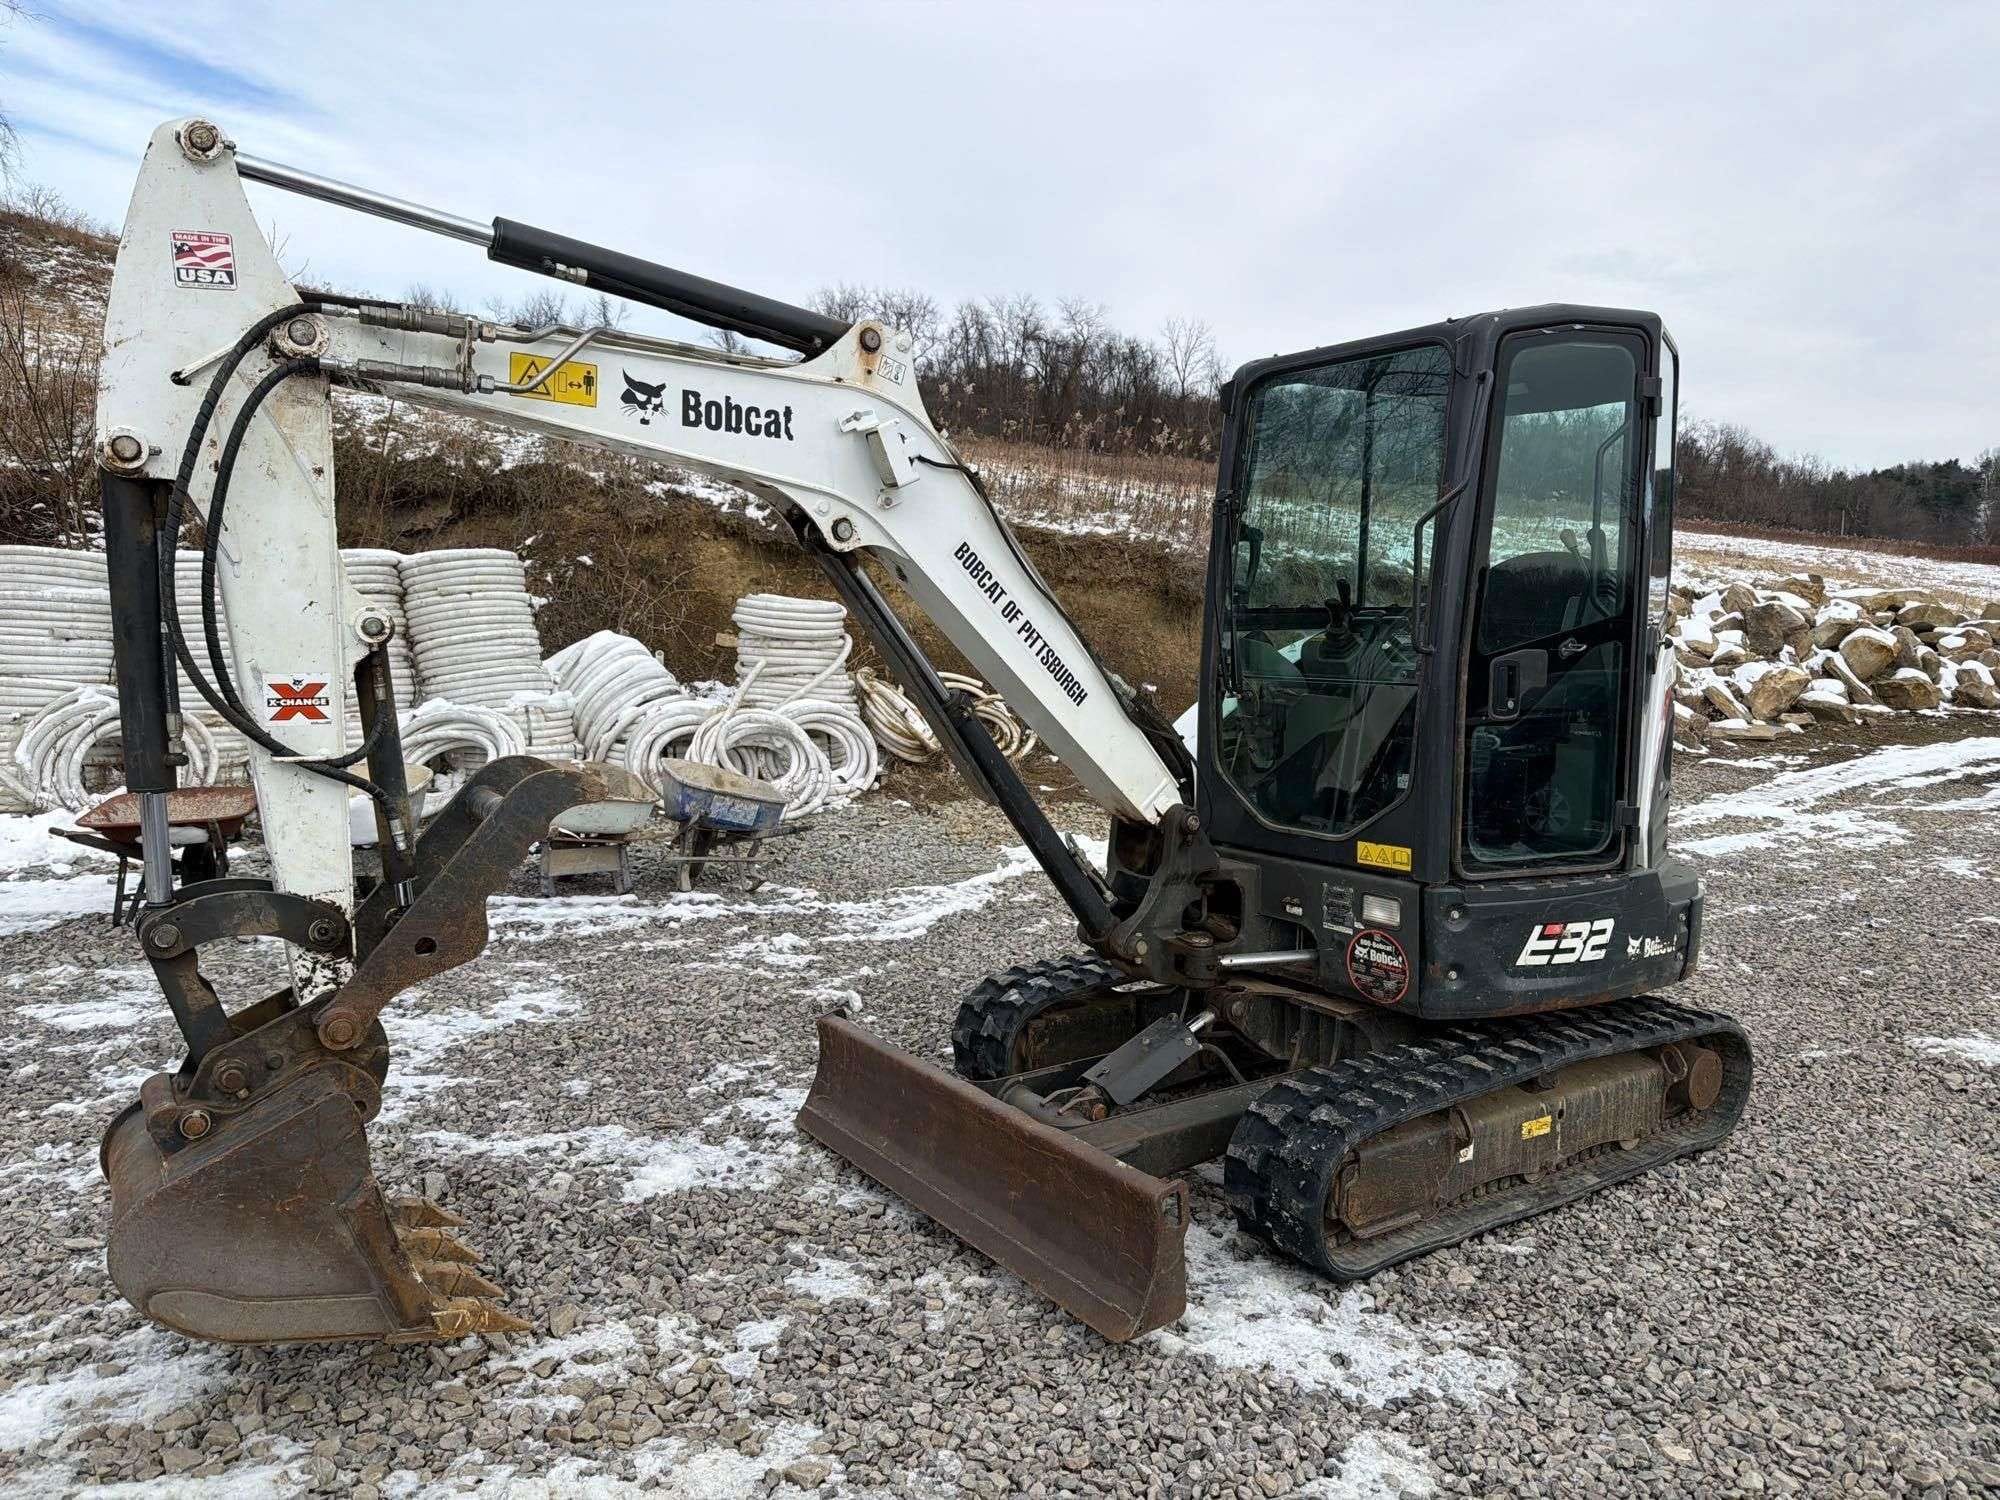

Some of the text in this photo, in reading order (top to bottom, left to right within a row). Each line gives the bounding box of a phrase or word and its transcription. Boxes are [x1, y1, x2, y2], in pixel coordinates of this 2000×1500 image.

[174, 233, 199, 241] MADE
[178, 268, 231, 283] USA
[681, 389, 794, 441] Bobcat
[953, 541, 1088, 707] BOBCAT OF PITTSBURGH
[268, 698, 327, 706] X-CHANGE
[1515, 917, 1616, 966] E32
[1369, 949, 1403, 968] Bobcat
